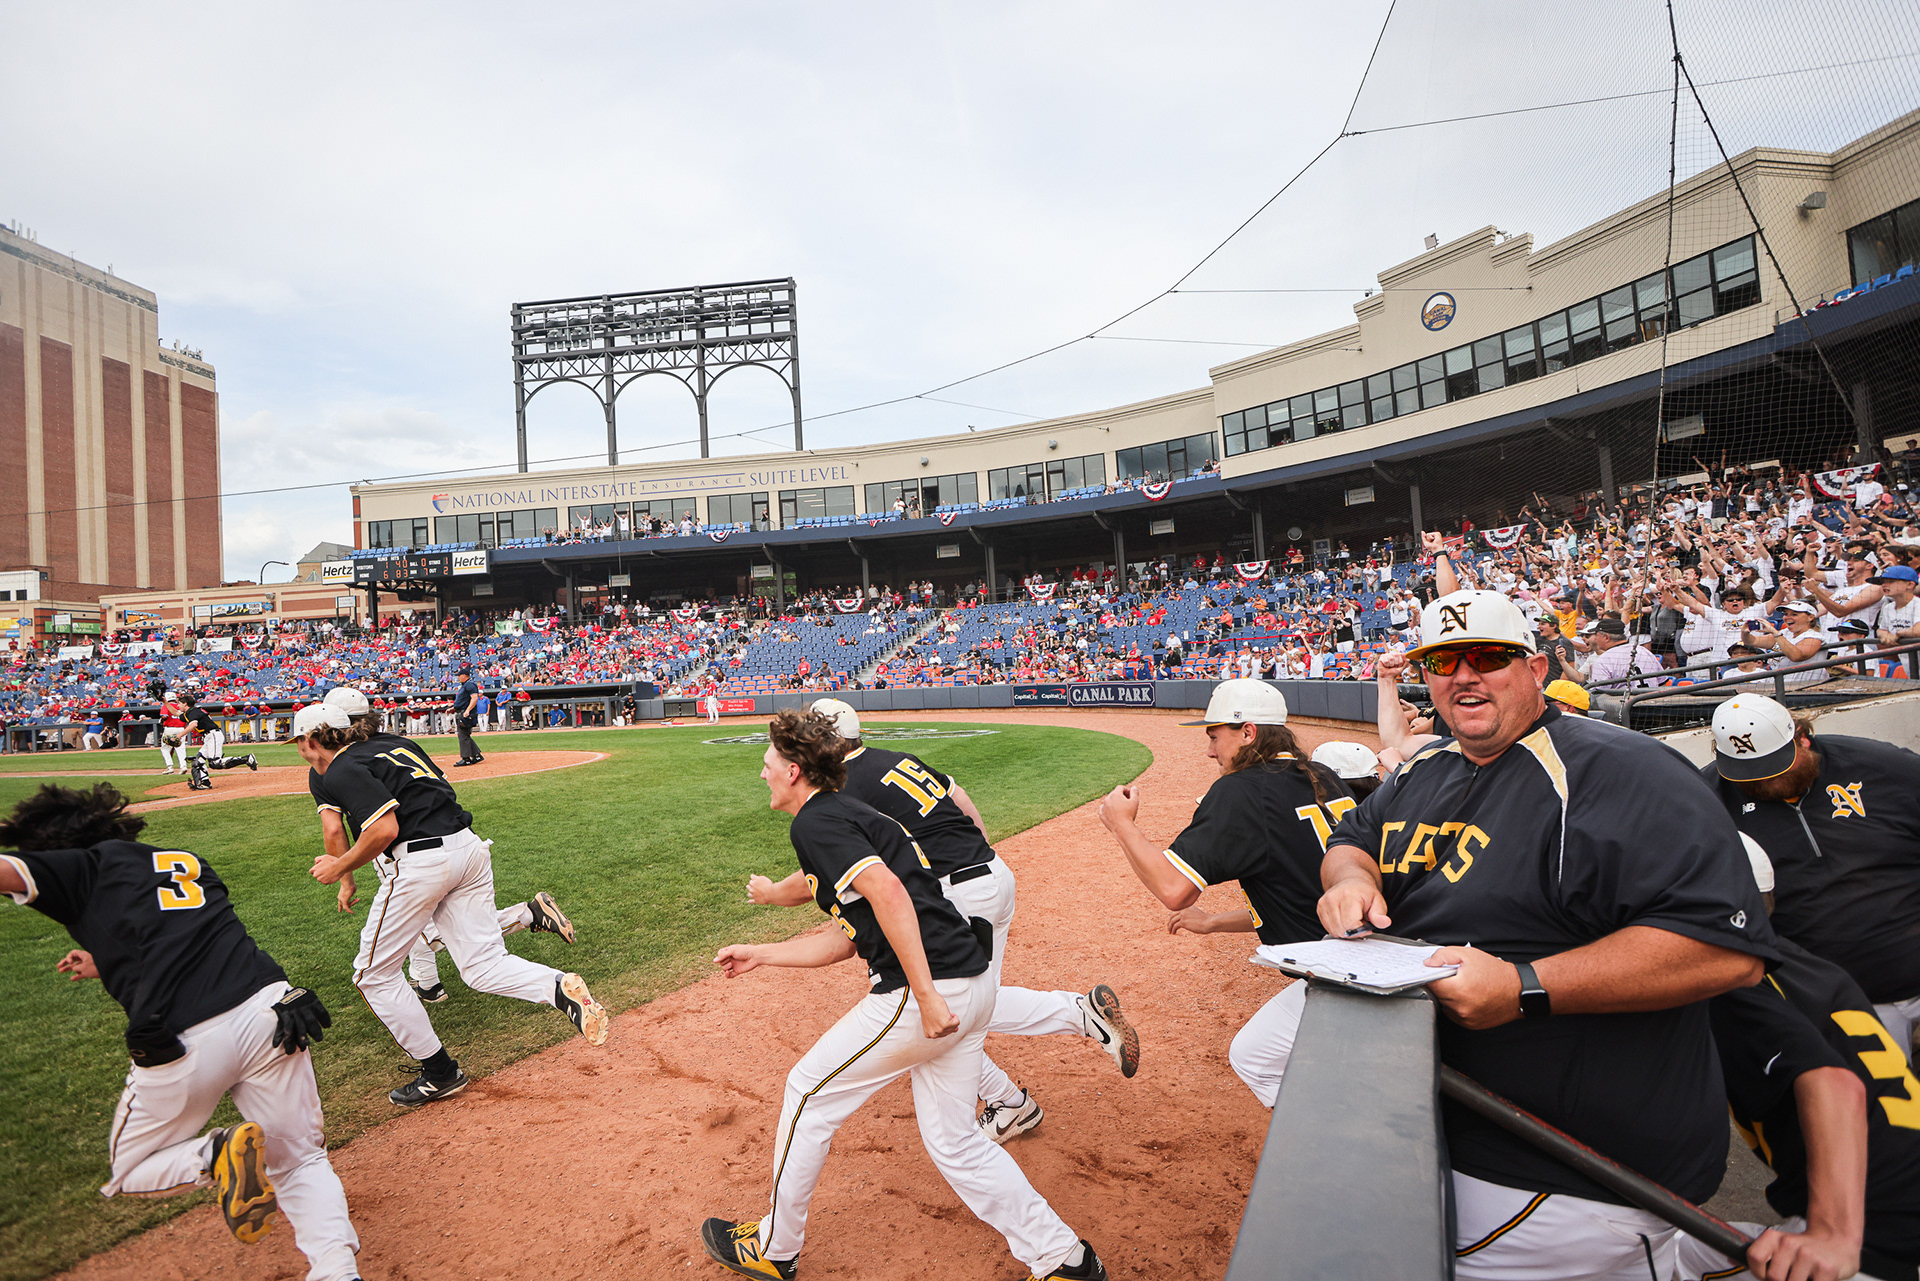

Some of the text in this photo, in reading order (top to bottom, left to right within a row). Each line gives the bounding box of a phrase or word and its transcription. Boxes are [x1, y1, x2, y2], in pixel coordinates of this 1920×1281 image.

[452, 465, 849, 509] NATIONAL INTERSTATE INSURANCE SUITE LEVEL
[323, 565, 354, 577] Hertz
[395, 560, 401, 568] 4
[402, 559, 408, 568] 0
[421, 557, 427, 567] 0
[454, 554, 486, 567] Hertz
[383, 570, 389, 579] 6
[395, 569, 401, 578] 8
[403, 569, 408, 578] 3
[443, 566, 449, 575] 2
[1439, 602, 1472, 636] N
[1072, 686, 1152, 702] CANAL PARK
[1729, 732, 1757, 755] N
[880, 757, 947, 818] 15
[1825, 781, 1867, 820] N
[152, 850, 206, 911] 3
[737, 1241, 760, 1263] N
